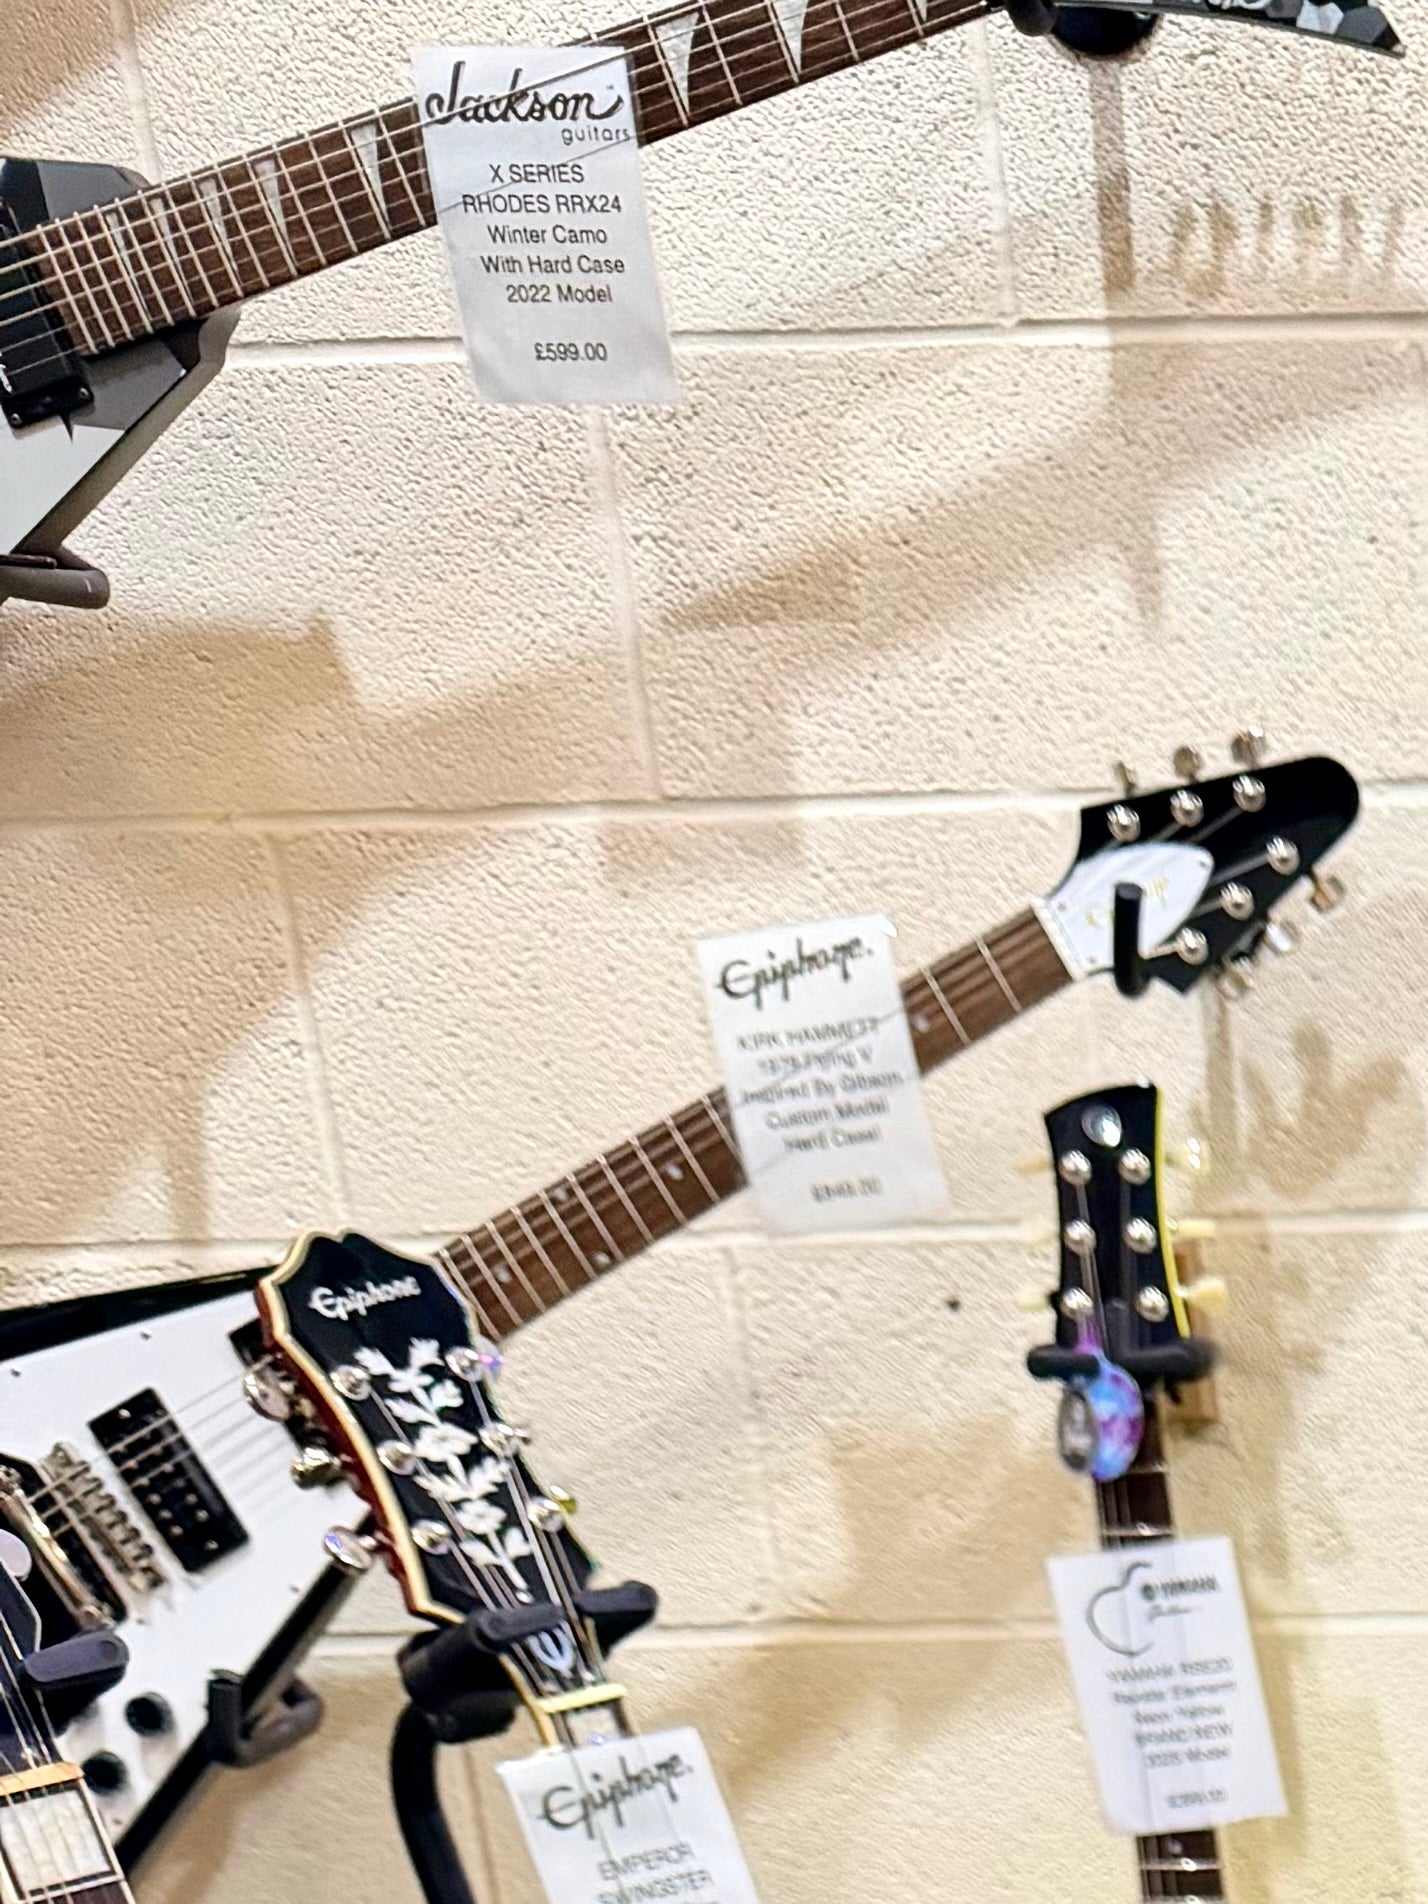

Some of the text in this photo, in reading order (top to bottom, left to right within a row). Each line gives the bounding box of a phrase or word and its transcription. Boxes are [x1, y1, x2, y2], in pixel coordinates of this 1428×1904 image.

[425, 60, 624, 124] Jackson
[561, 127, 632, 146] guitars
[489, 164, 585, 184] X SERIES
[462, 194, 622, 214] RHODES RRX24
[486, 224, 607, 245] Winter Camo
[480, 255, 625, 275] With Hard Case
[506, 284, 613, 304] 2022 Model
[534, 342, 608, 363] £599.00
[308, 1275, 422, 1321] Epiphone
[597, 1840, 696, 1881] EMPEROR
